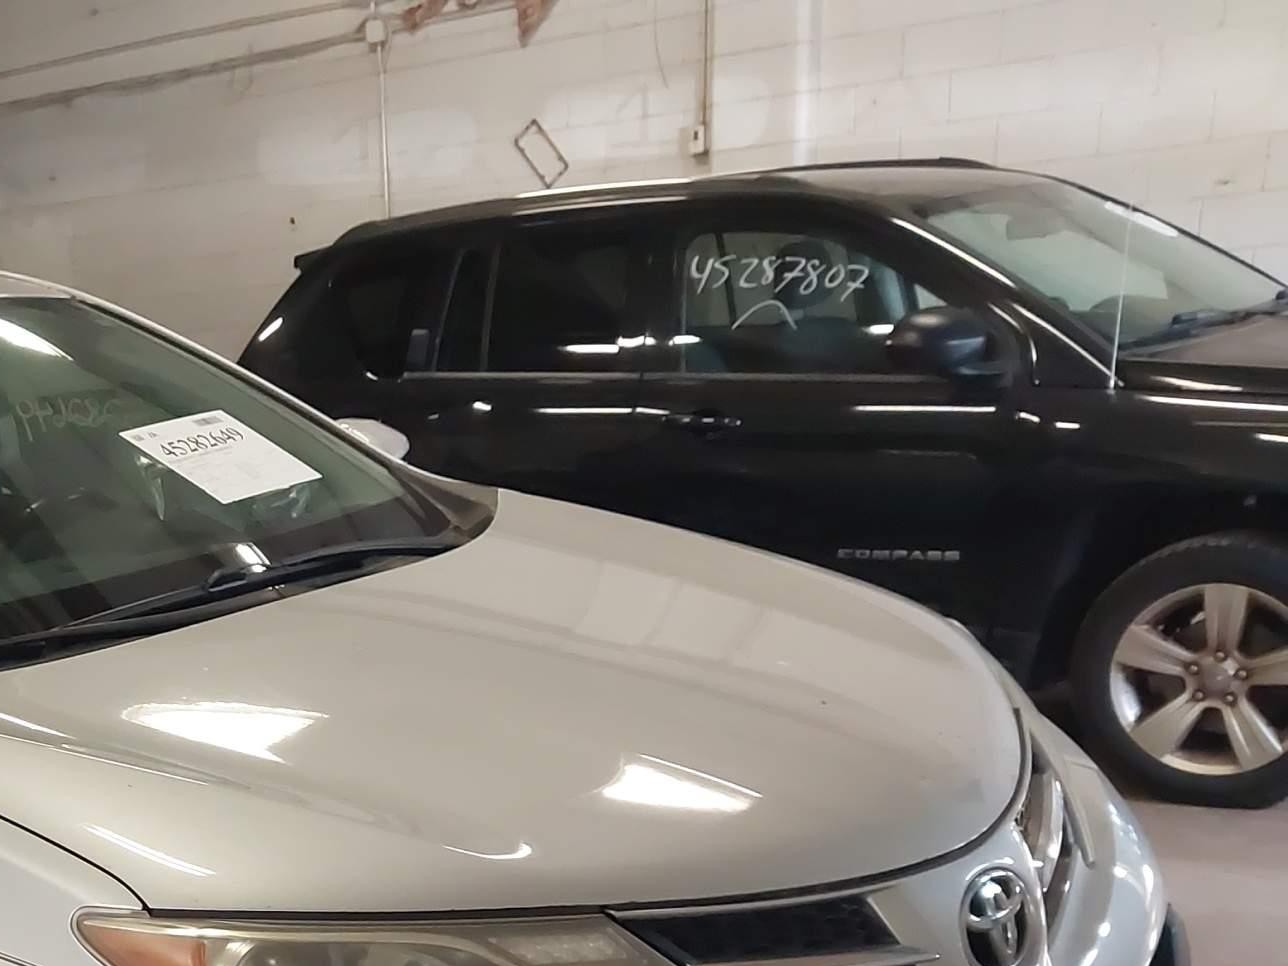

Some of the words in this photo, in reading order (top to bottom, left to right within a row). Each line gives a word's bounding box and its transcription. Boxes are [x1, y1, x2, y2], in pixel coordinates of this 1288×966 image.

[690, 254, 869, 302] 45287807
[159, 427, 245, 458] 45282649
[837, 549, 960, 561] COMPASS
